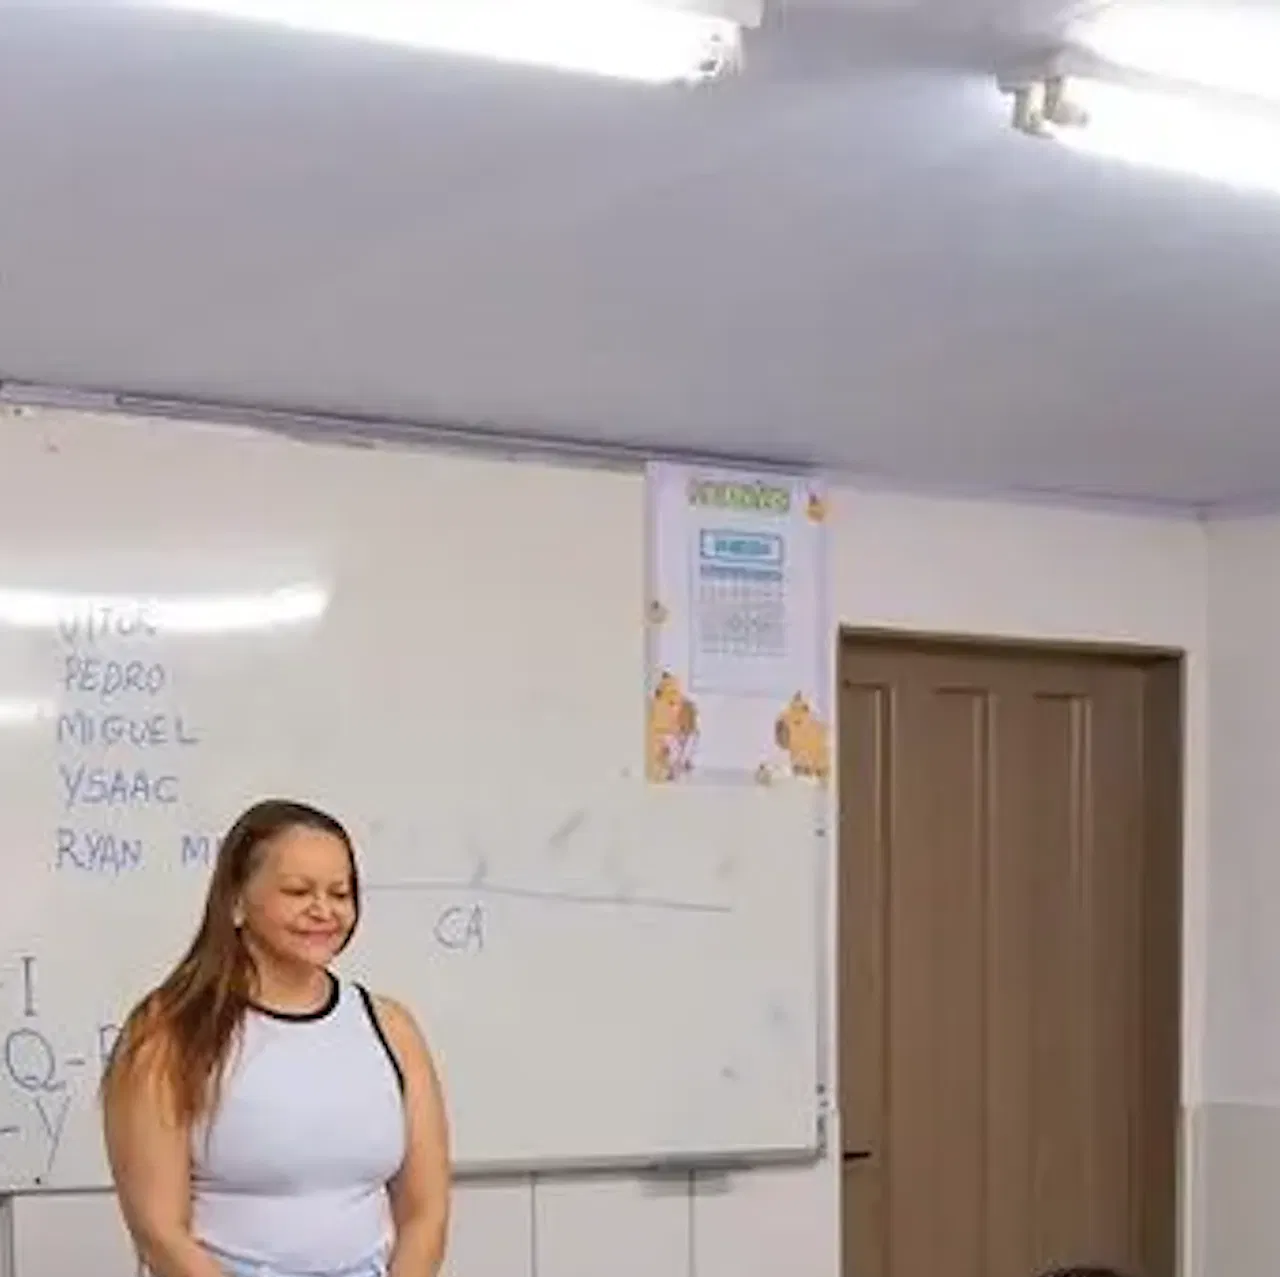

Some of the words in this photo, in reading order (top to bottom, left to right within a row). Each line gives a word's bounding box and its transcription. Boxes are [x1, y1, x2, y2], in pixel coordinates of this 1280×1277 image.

[62, 658, 166, 694] PEDRO
[56, 717, 202, 746] MIGUEL
[59, 766, 178, 802] YSAAC
[54, 829, 142, 871] RYAN
